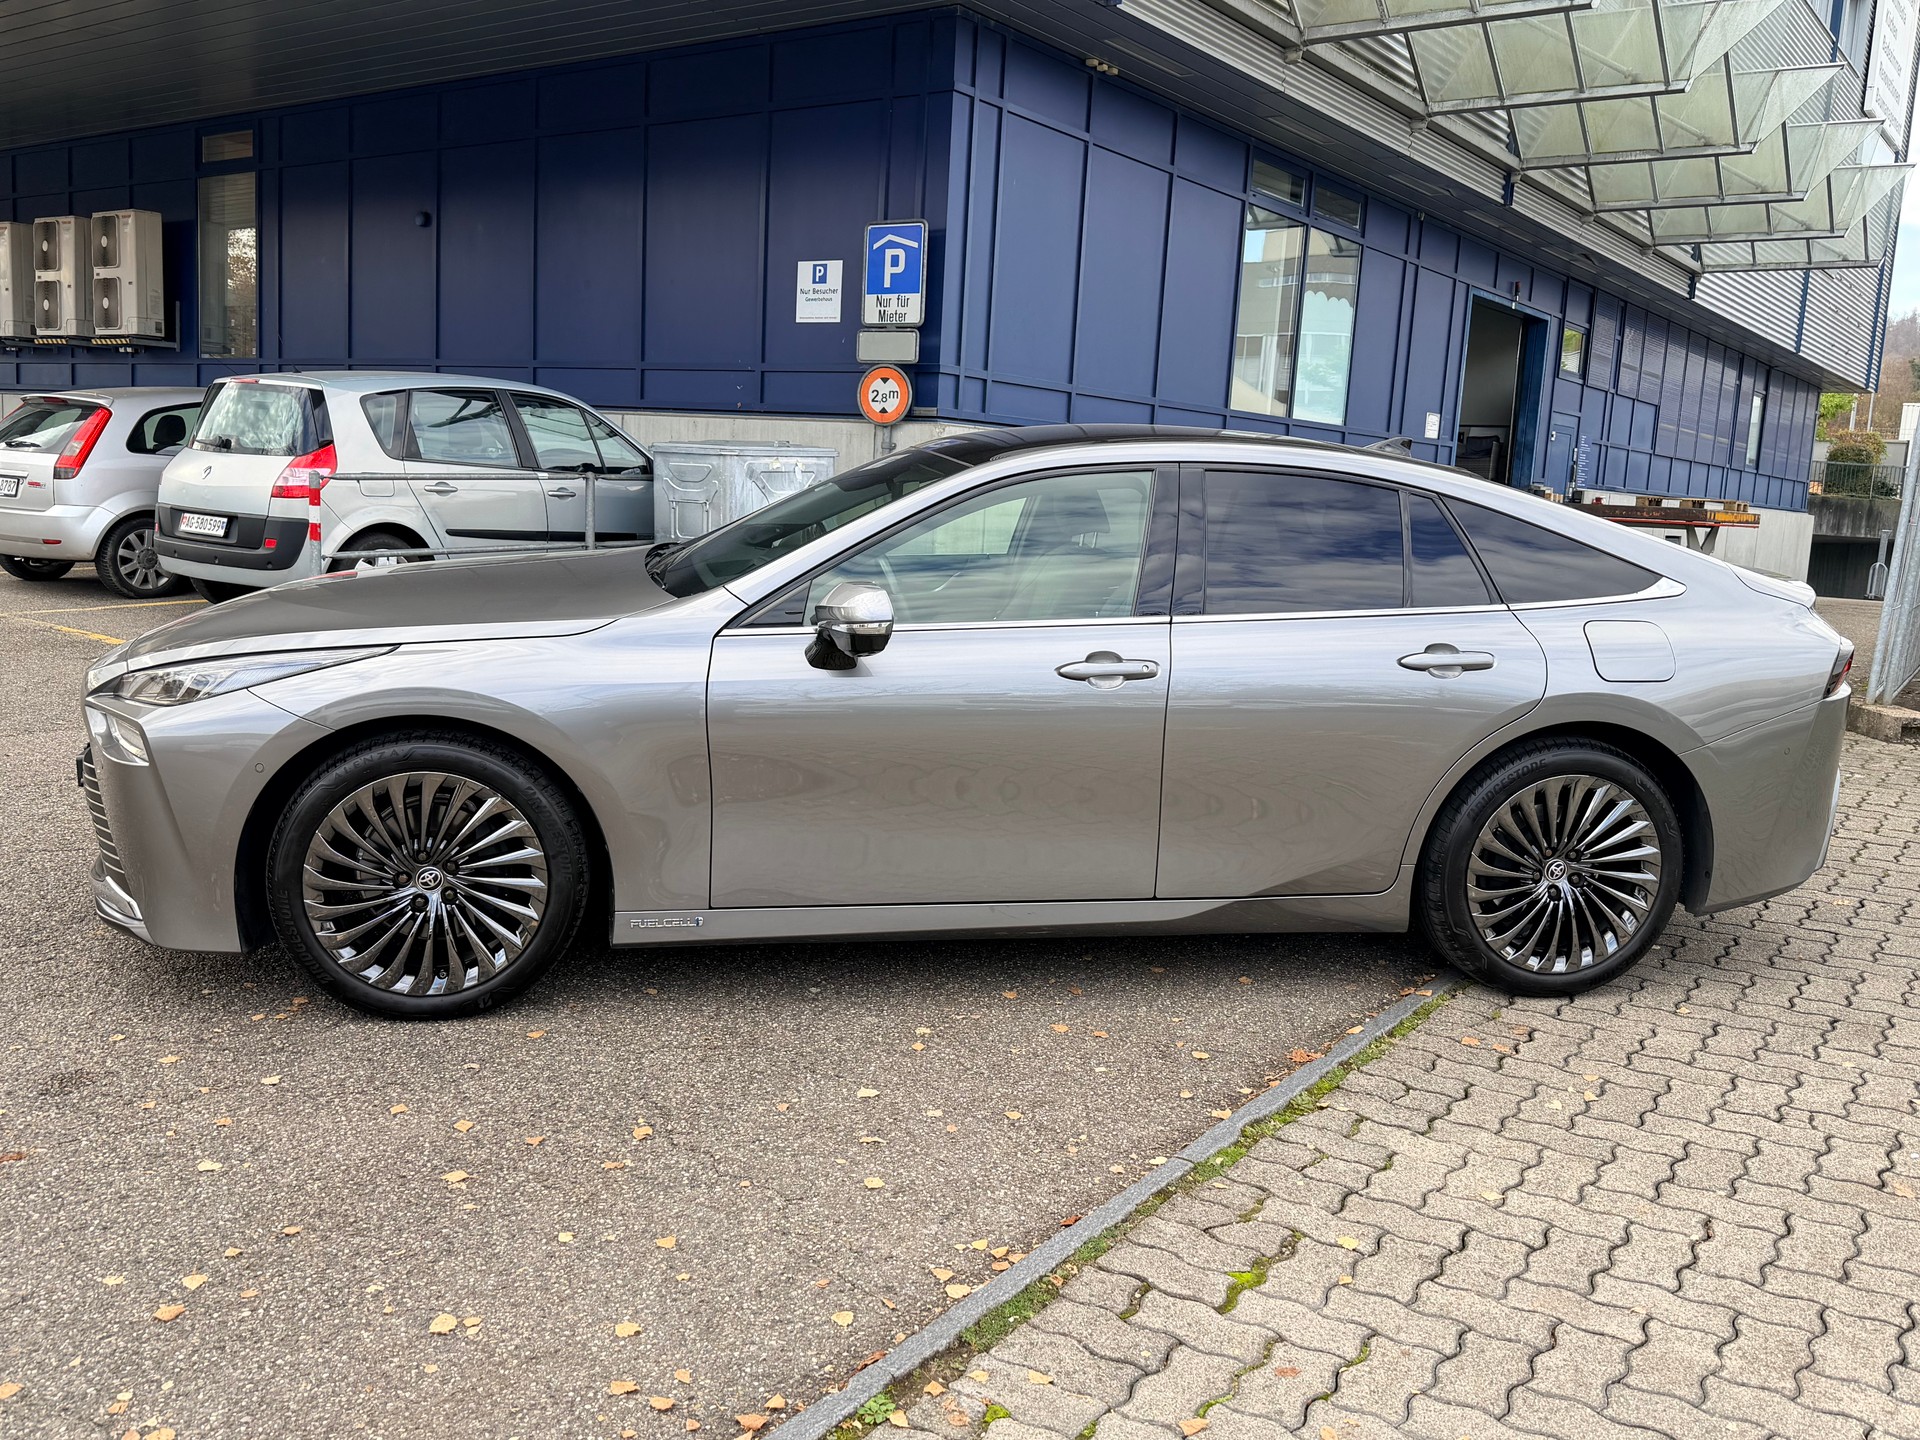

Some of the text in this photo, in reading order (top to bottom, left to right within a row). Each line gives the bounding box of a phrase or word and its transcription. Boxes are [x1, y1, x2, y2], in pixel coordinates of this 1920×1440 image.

[815, 266, 825, 282] P
[883, 248, 906, 288] P
[812, 287, 839, 295] Besucher
[875, 294, 910, 308] Nur für
[877, 309, 908, 323] Mieter
